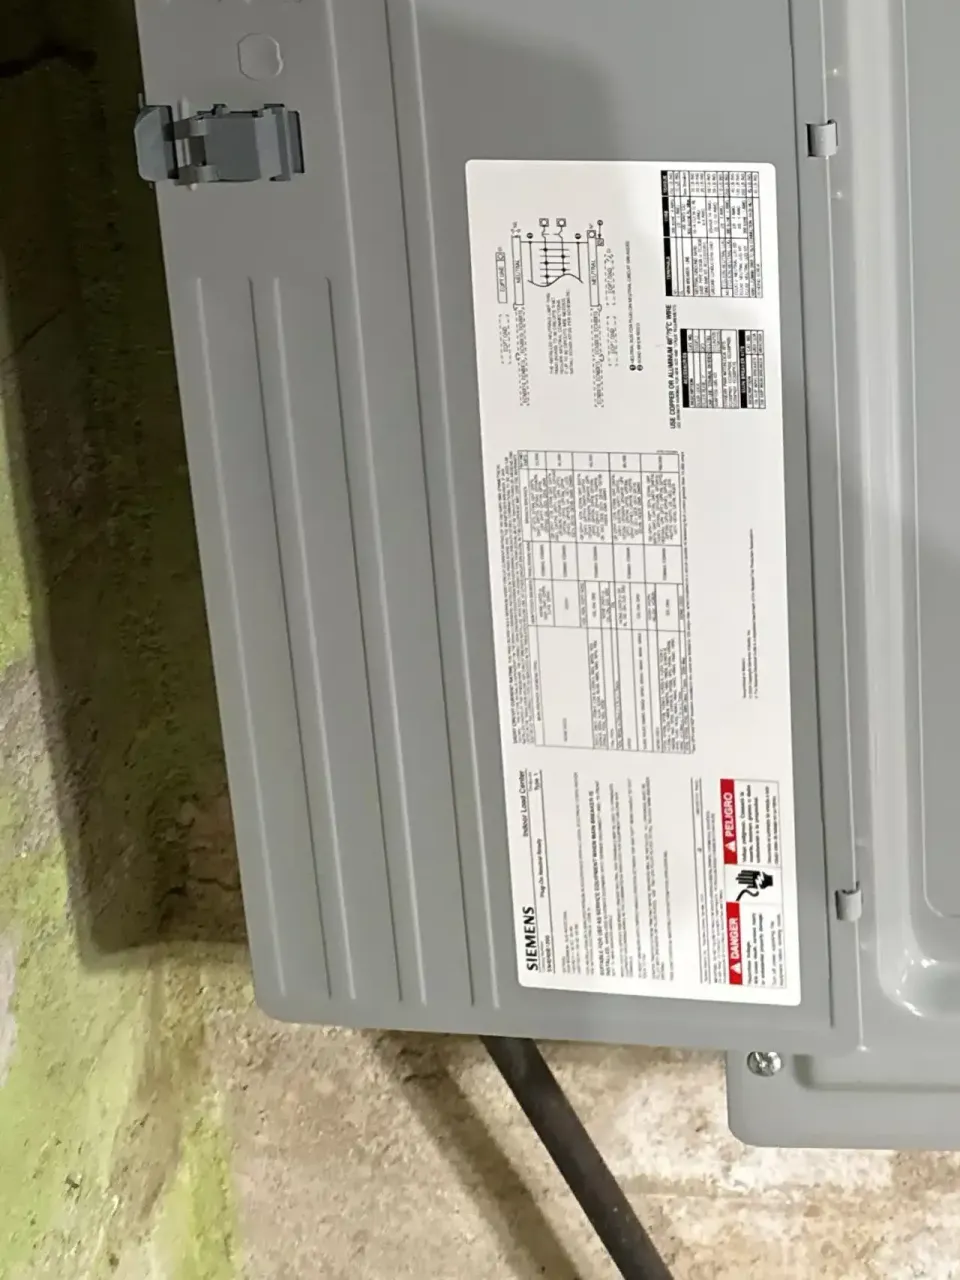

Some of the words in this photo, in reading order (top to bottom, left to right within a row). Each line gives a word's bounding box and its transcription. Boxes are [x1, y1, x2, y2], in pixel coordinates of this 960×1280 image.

[668, 379, 675, 390] OR
[668, 391, 676, 415] COPPER
[723, 792, 734, 837] PELIGRO
[522, 906, 539, 971] SIEMENS
[728, 917, 740, 960] DANGER
